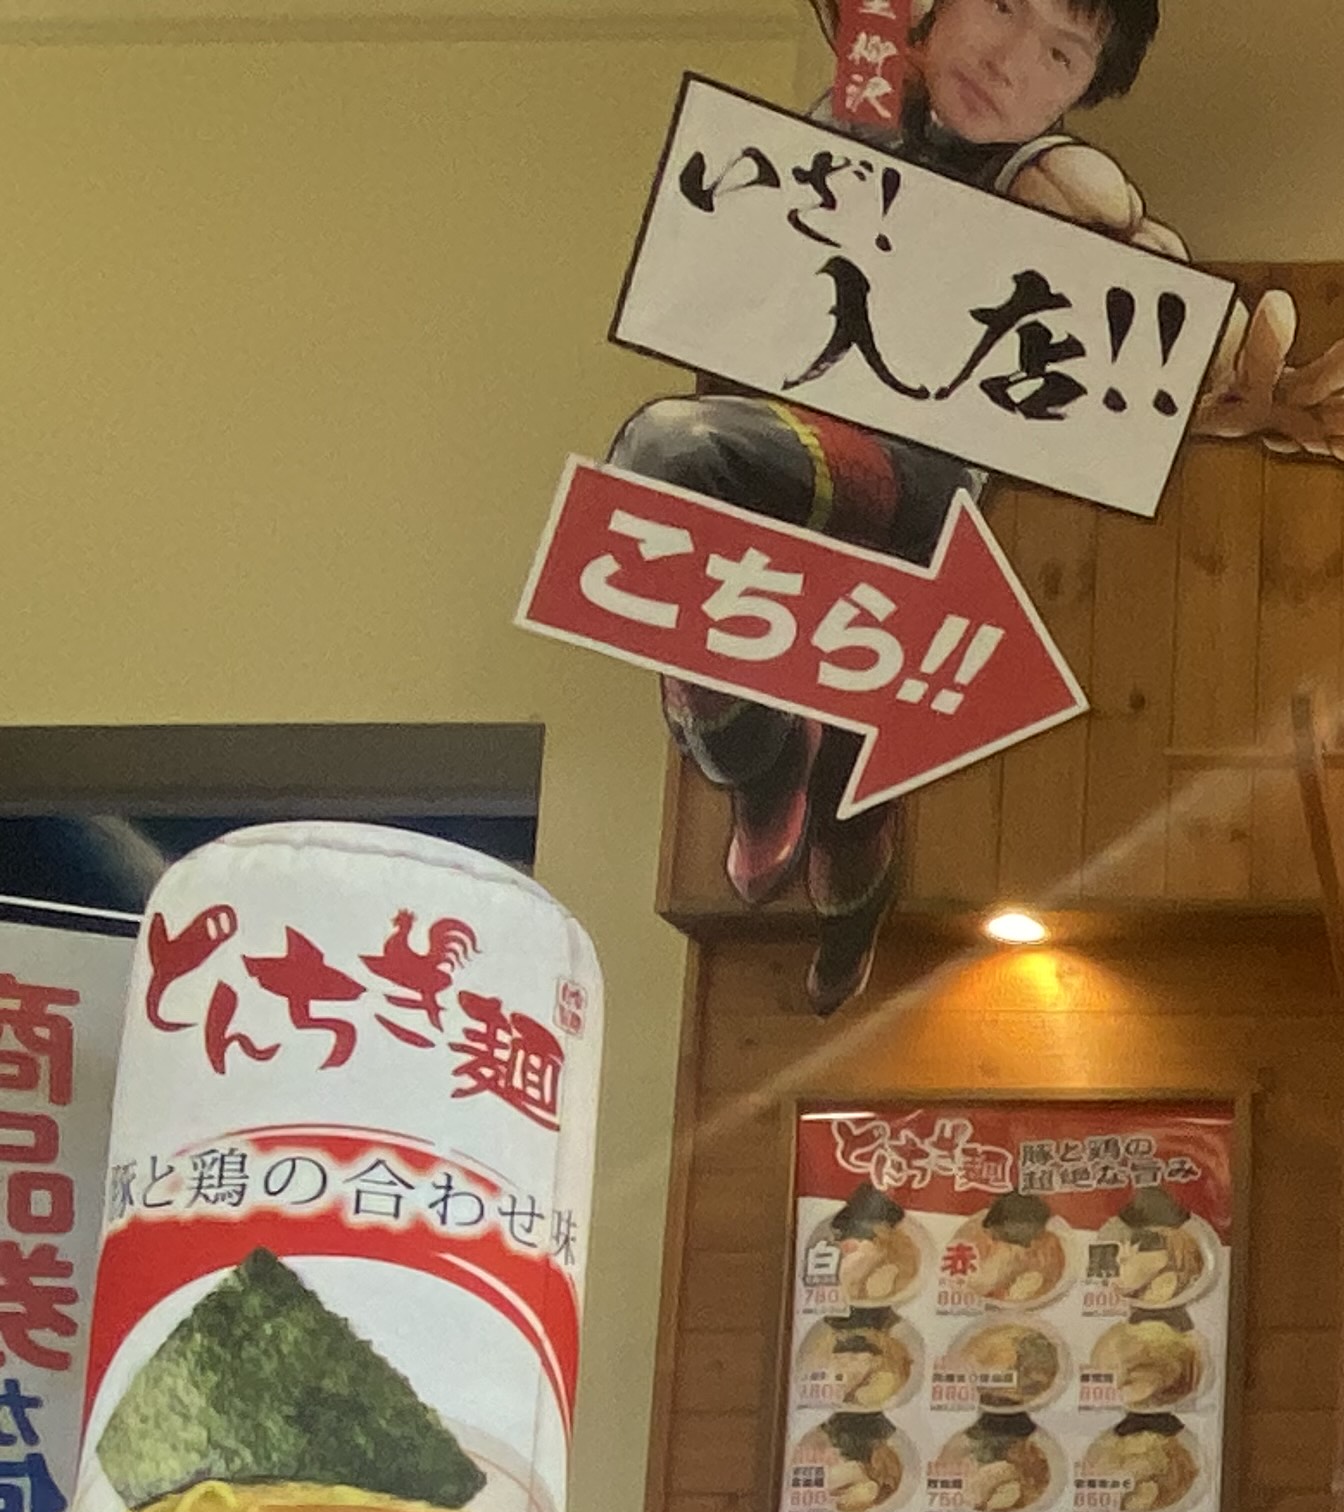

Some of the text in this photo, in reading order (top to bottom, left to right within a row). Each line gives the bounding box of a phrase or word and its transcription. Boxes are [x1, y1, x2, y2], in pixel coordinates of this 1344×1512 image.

[782, 255, 1187, 421] 入店!!
[580, 510, 1005, 716] こちら!!
[942, 1242, 978, 1276] 赤
